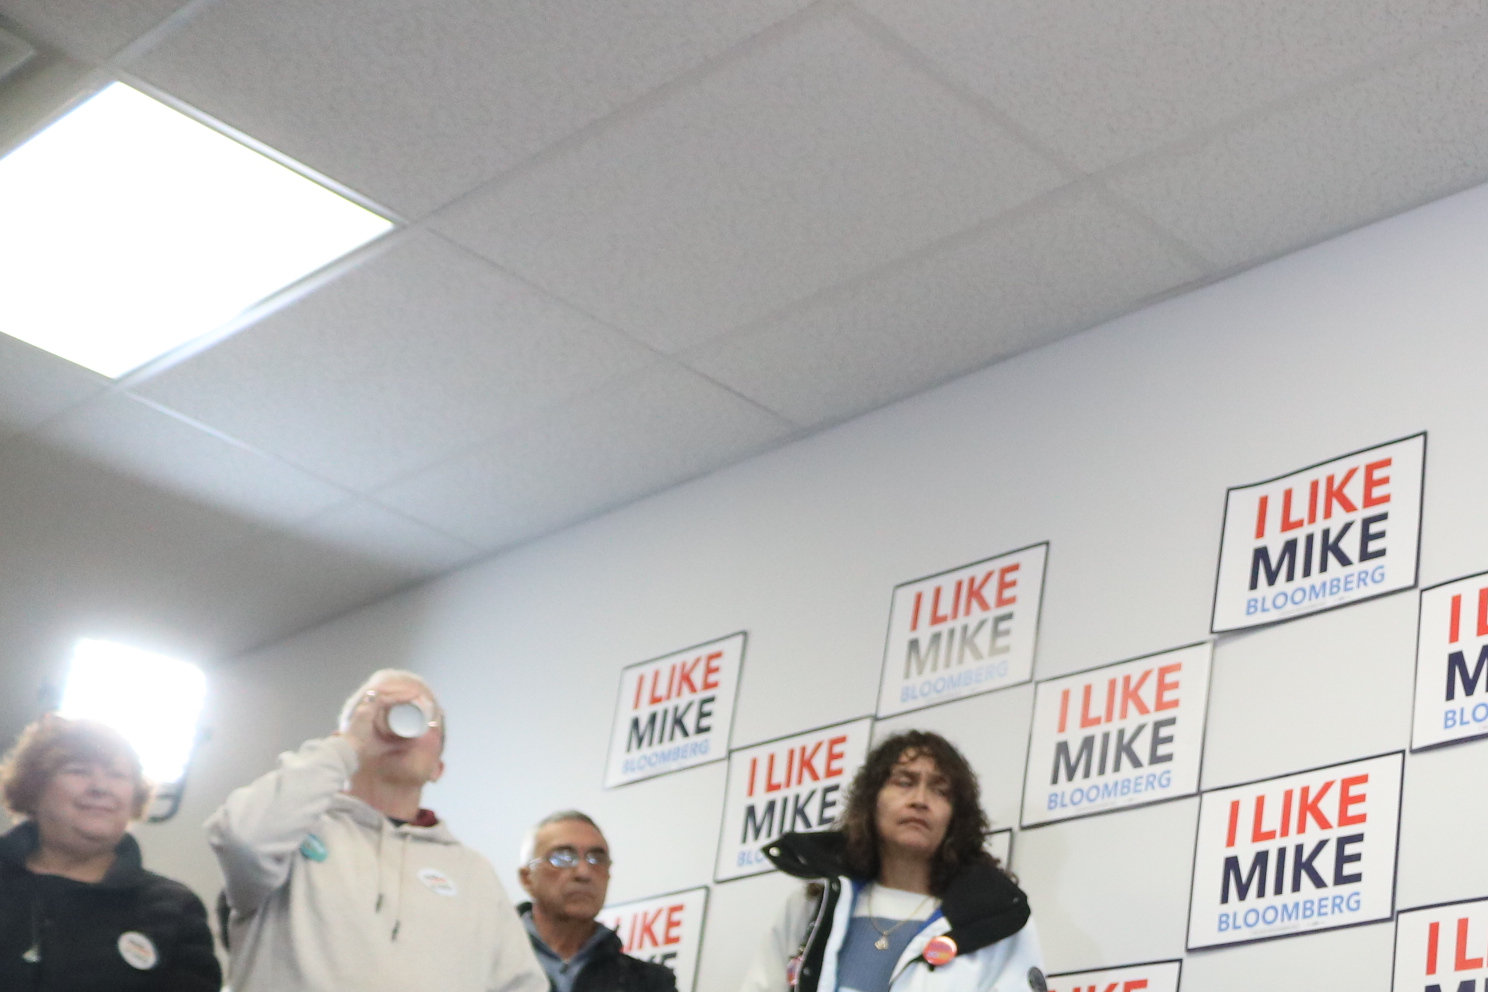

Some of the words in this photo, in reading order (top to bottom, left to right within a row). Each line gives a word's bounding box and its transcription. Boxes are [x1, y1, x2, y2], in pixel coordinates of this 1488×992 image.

[1254, 495, 1269, 540] I
[1280, 457, 1393, 533] LIKE
[1249, 512, 1389, 591] MIKE
[910, 591, 922, 632] I
[929, 562, 1021, 626] LIKE
[1245, 564, 1386, 616] BLOOMBERG
[1448, 593, 1463, 644] I
[903, 611, 1014, 680] MIKE
[632, 673, 644, 710] I
[648, 650, 723, 706] LIKE
[1057, 689, 1070, 733] I
[1080, 662, 1182, 729] LIKE
[626, 695, 716, 753] MIKE
[1051, 717, 1177, 785] MIKE
[747, 757, 757, 797] I
[765, 734, 848, 793] LIKE
[1047, 769, 1172, 811] BLOOMBERG
[740, 783, 840, 844] MIKE
[1225, 799, 1241, 848] I
[1251, 773, 1370, 844] LIKE
[1220, 832, 1365, 905] MIKE
[1217, 890, 1361, 933] BLOOMBERG
[1425, 921, 1441, 976] I
